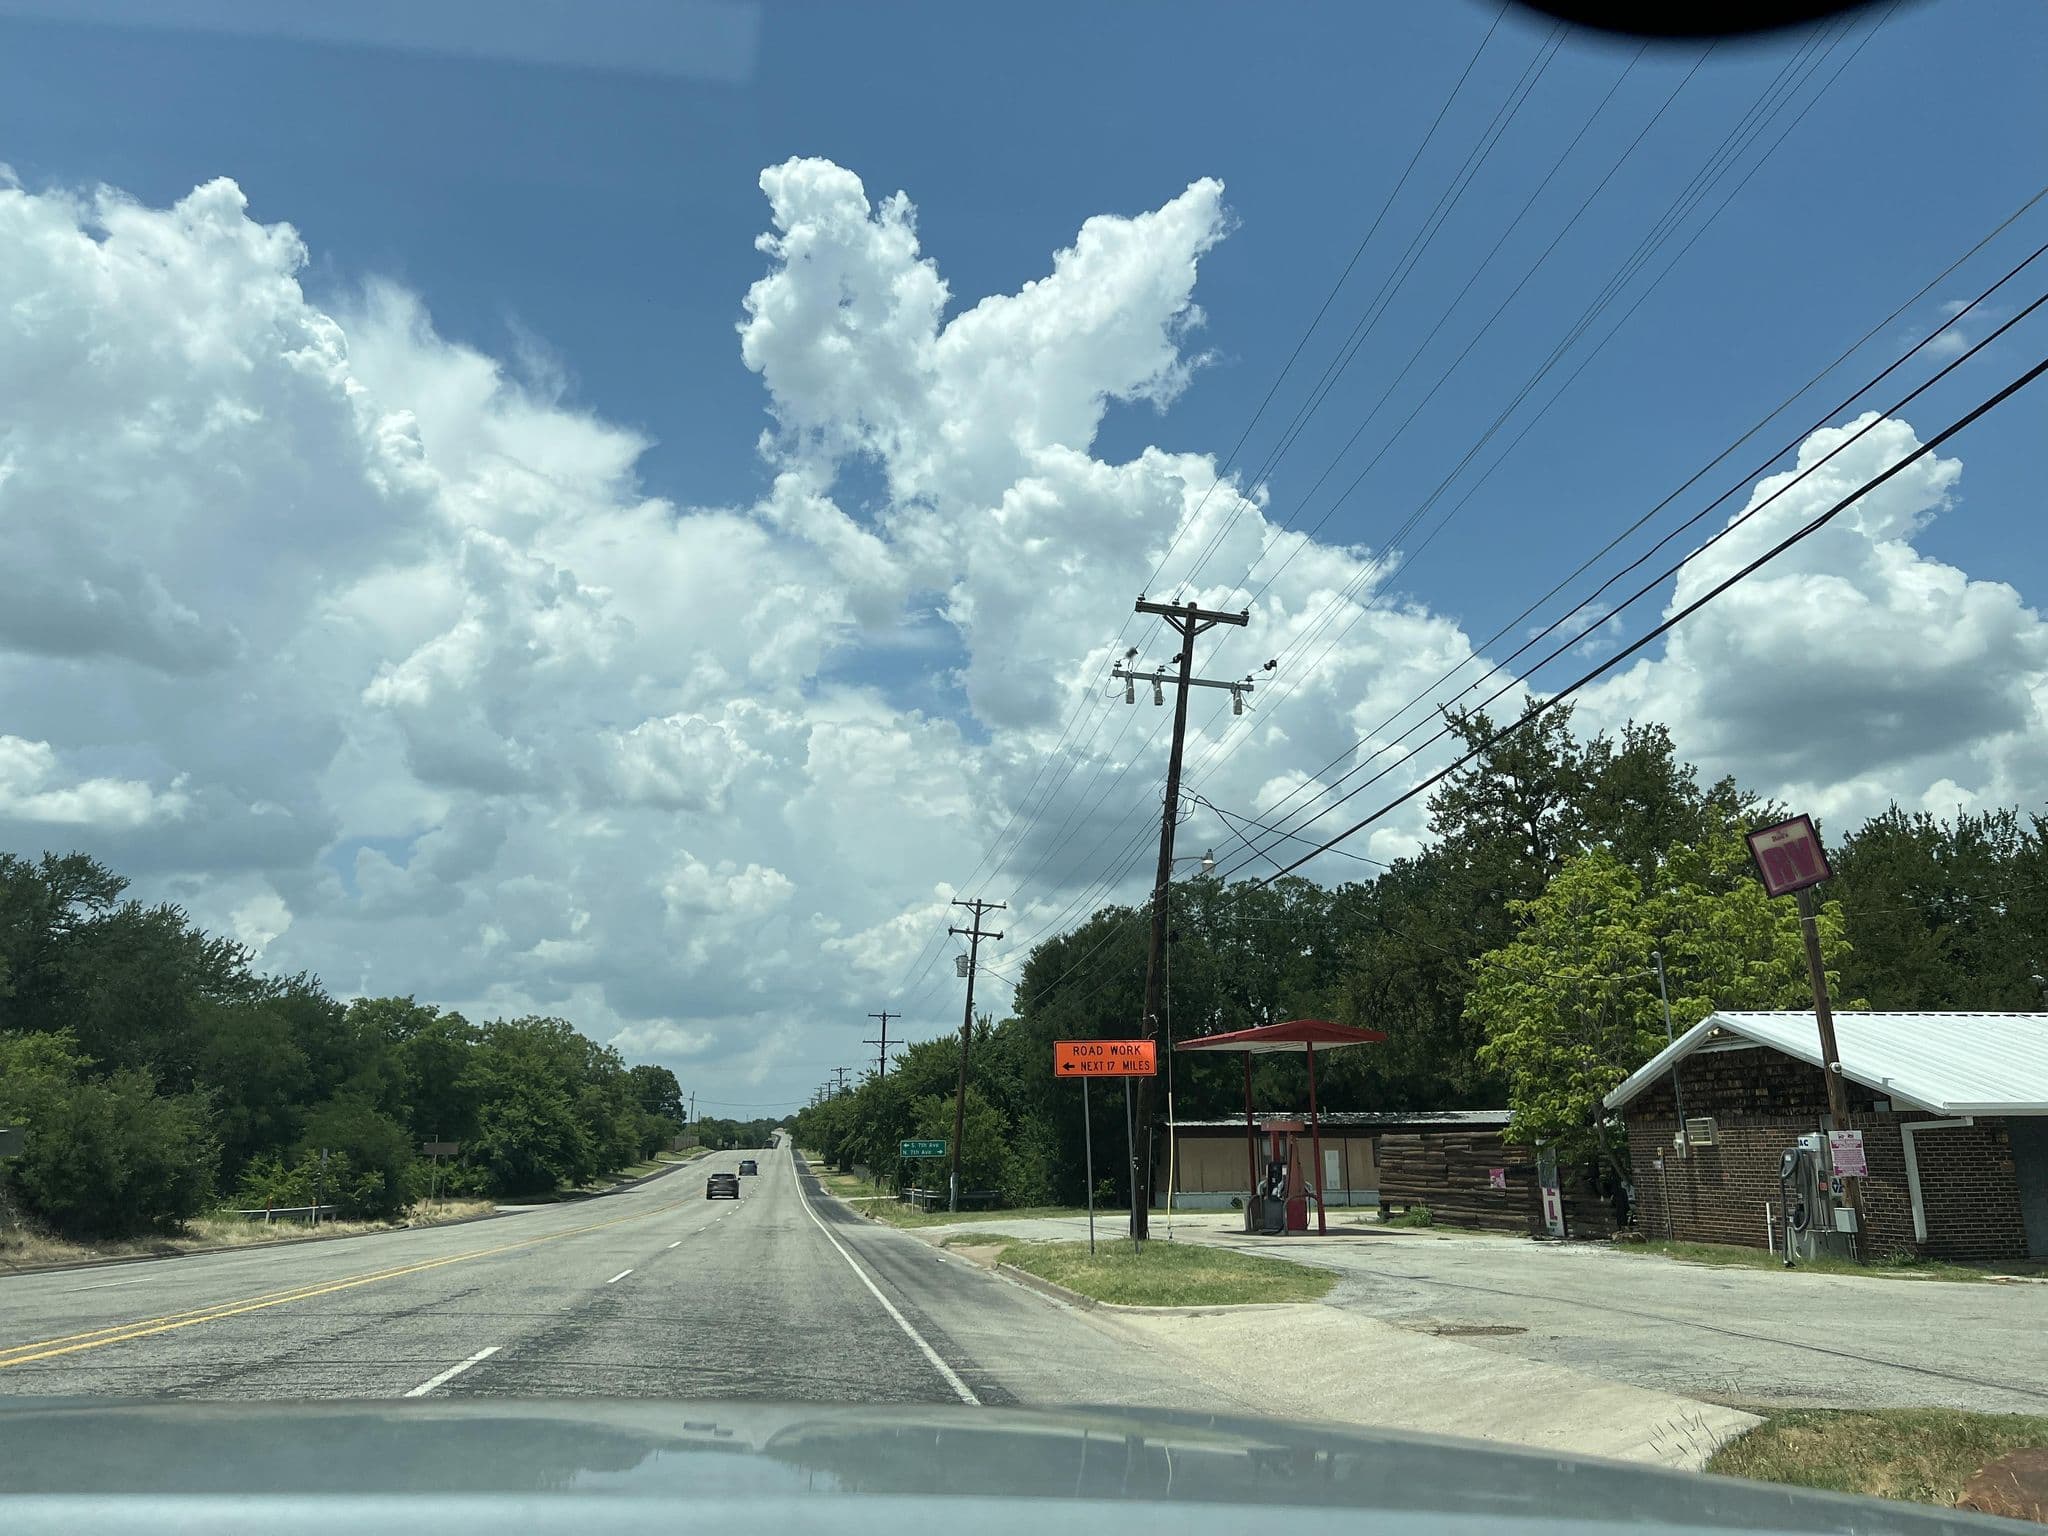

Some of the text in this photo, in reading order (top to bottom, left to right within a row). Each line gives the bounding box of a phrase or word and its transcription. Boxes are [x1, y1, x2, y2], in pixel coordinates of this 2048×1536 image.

[1073, 1045, 1141, 1056] ROAD WORK
[1080, 1060, 1150, 1071] NEXT 17 MILES
